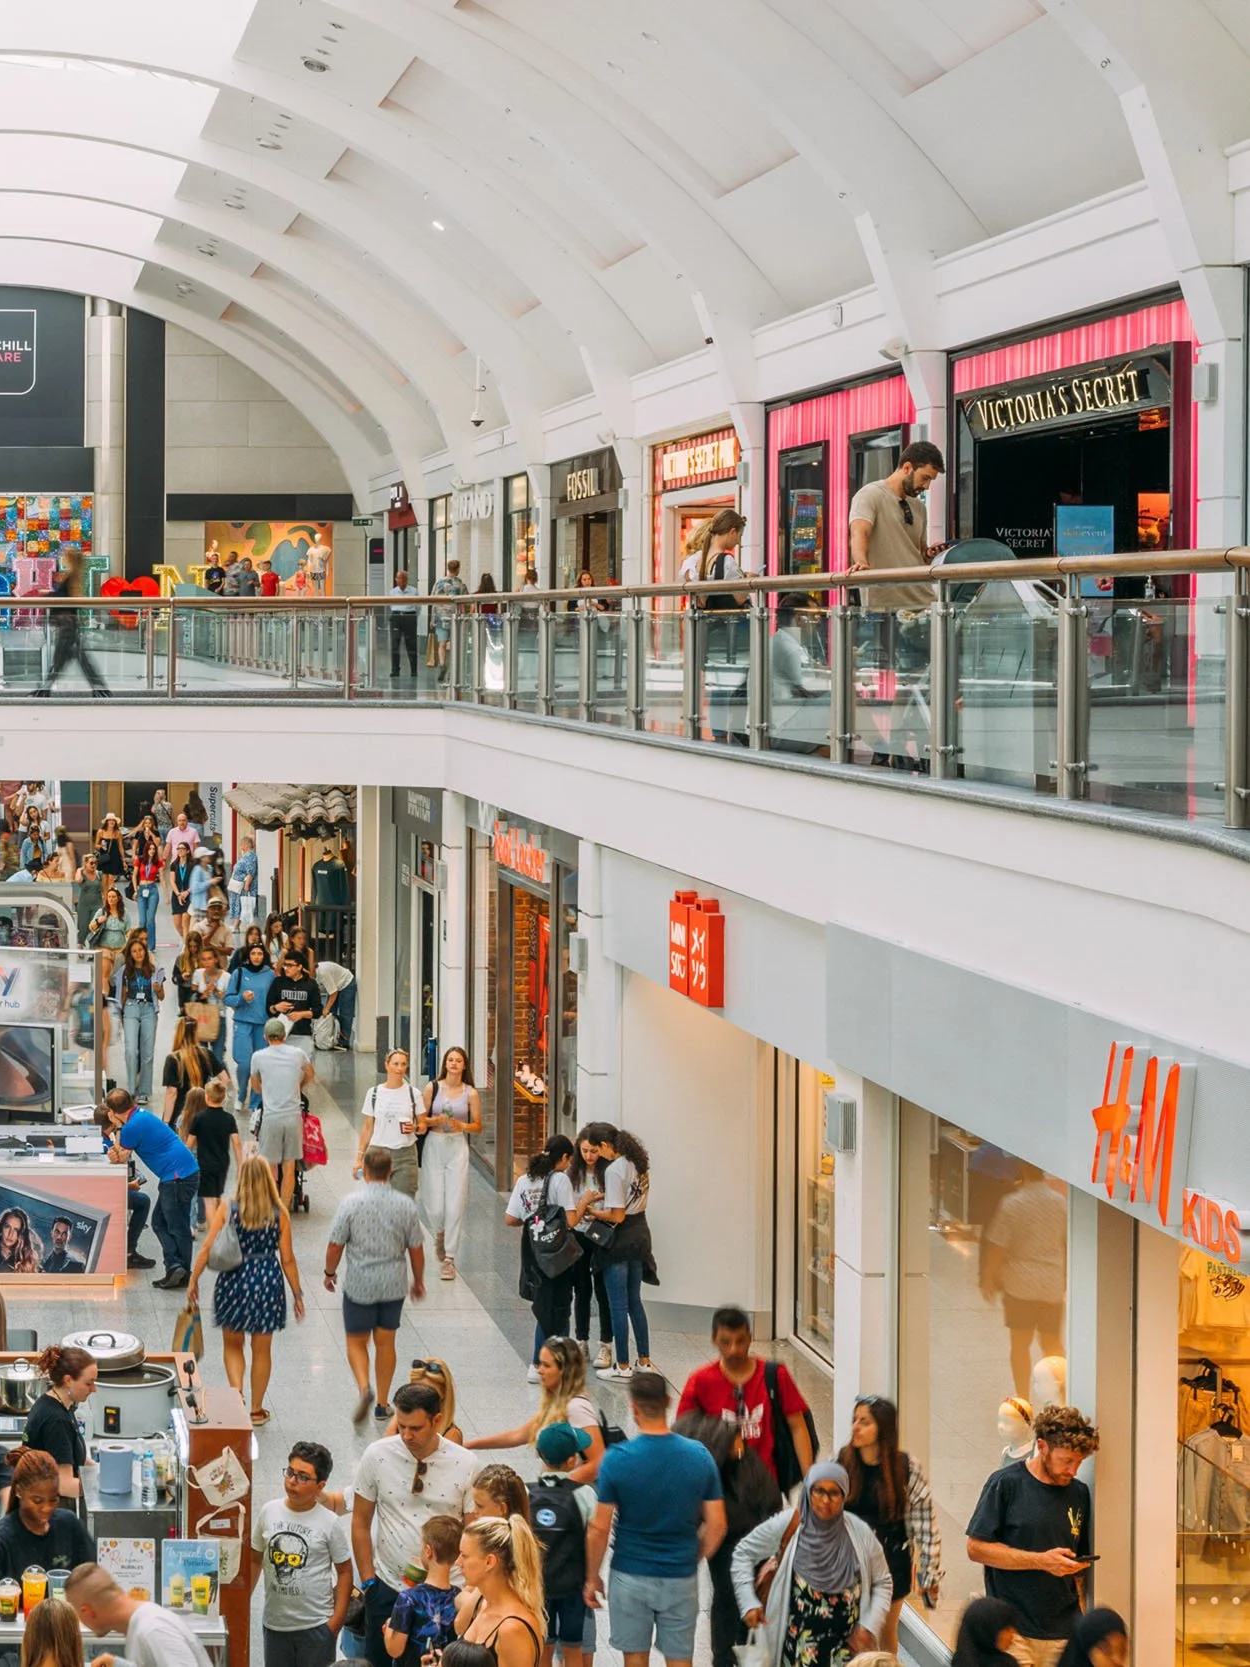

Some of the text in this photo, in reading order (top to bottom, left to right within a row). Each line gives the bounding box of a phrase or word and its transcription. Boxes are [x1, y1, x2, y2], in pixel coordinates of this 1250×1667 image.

[976, 370, 1140, 431] VICTORIA'S SECRET
[566, 467, 598, 502] FOSSIL
[1005, 538, 1048, 549] SECRET
[207, 785, 219, 832] Supercuts
[4, 999, 20, 1009] hub
[1091, 1041, 1181, 1227] H&M
[75, 1221, 92, 1234] sky
[1183, 1187, 1241, 1265] KIDS
